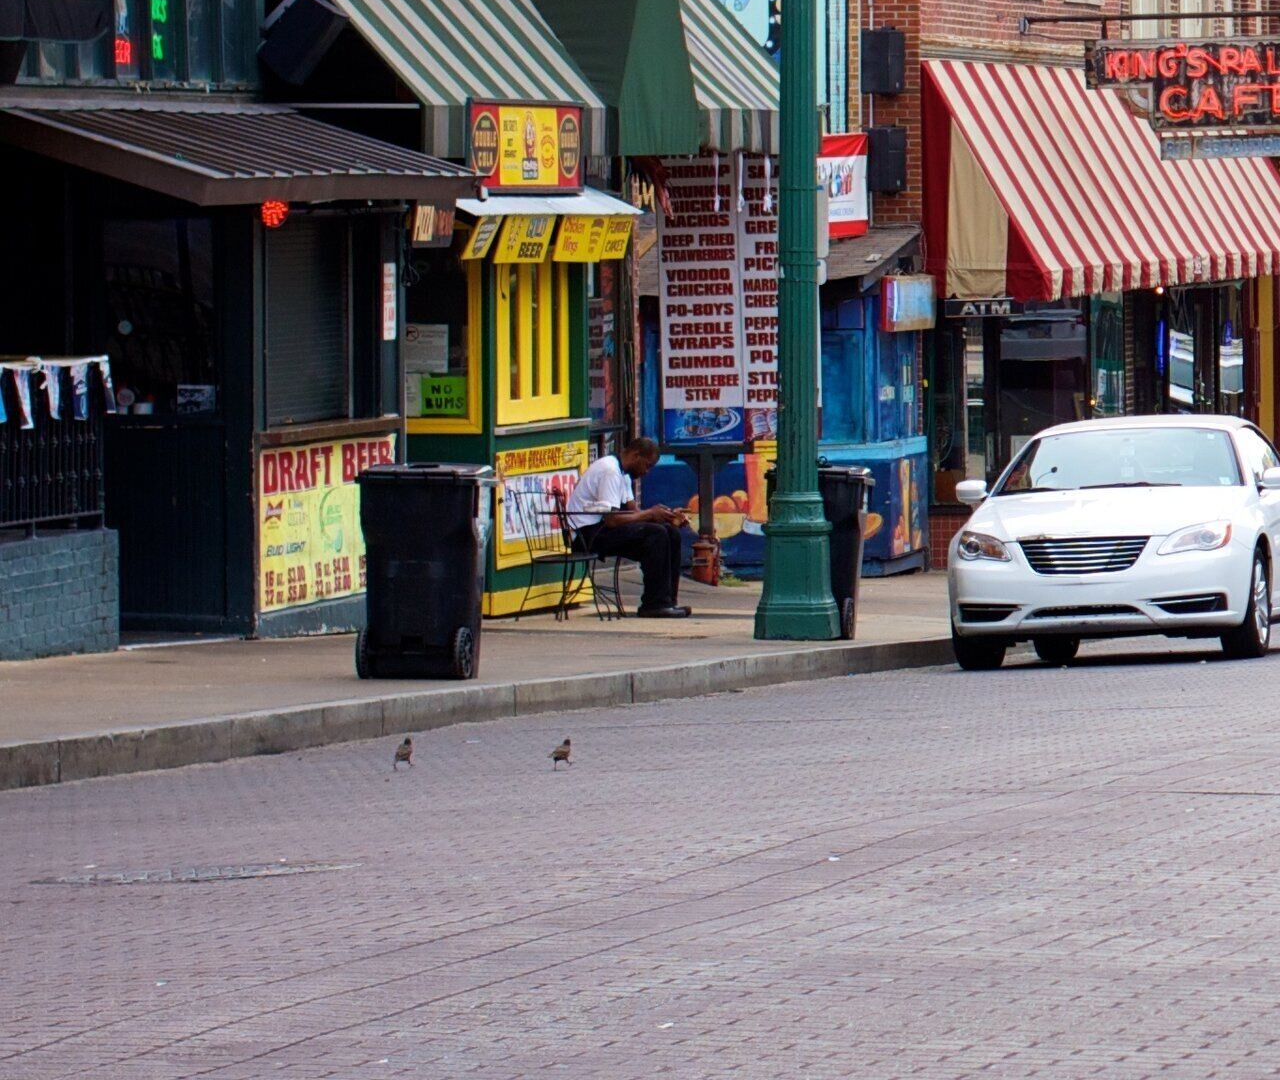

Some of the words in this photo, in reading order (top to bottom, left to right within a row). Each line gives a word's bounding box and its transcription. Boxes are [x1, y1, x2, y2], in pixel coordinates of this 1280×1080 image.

[1105, 43, 1207, 78] KING'S
[476, 131, 496, 147] DOUBLE
[478, 152, 493, 167] COLA
[665, 215, 729, 228] NACHOS
[604, 239, 625, 253] CAKES
[662, 235, 694, 248] DEEP
[699, 233, 734, 246] FRIED
[517, 243, 543, 258] BEER
[661, 248, 735, 262] STRAWBERRIES
[666, 268, 730, 282] VOODOO
[666, 283, 733, 297] CHICKEN
[666, 303, 734, 317] PO-BOYS
[960, 301, 1010, 315] ATM
[669, 322, 733, 336] CREOLE
[668, 337, 735, 350] WRAPS
[669, 355, 735, 369] GUMBO
[666, 374, 739, 389] BUMBLEBEE
[432, 384, 452, 395] NO
[685, 388, 721, 401] STEW
[425, 395, 464, 409] BUMS
[263, 446, 333, 495] DRAFT
[341, 441, 394, 483] BEER
[265, 571, 274, 587] 16
